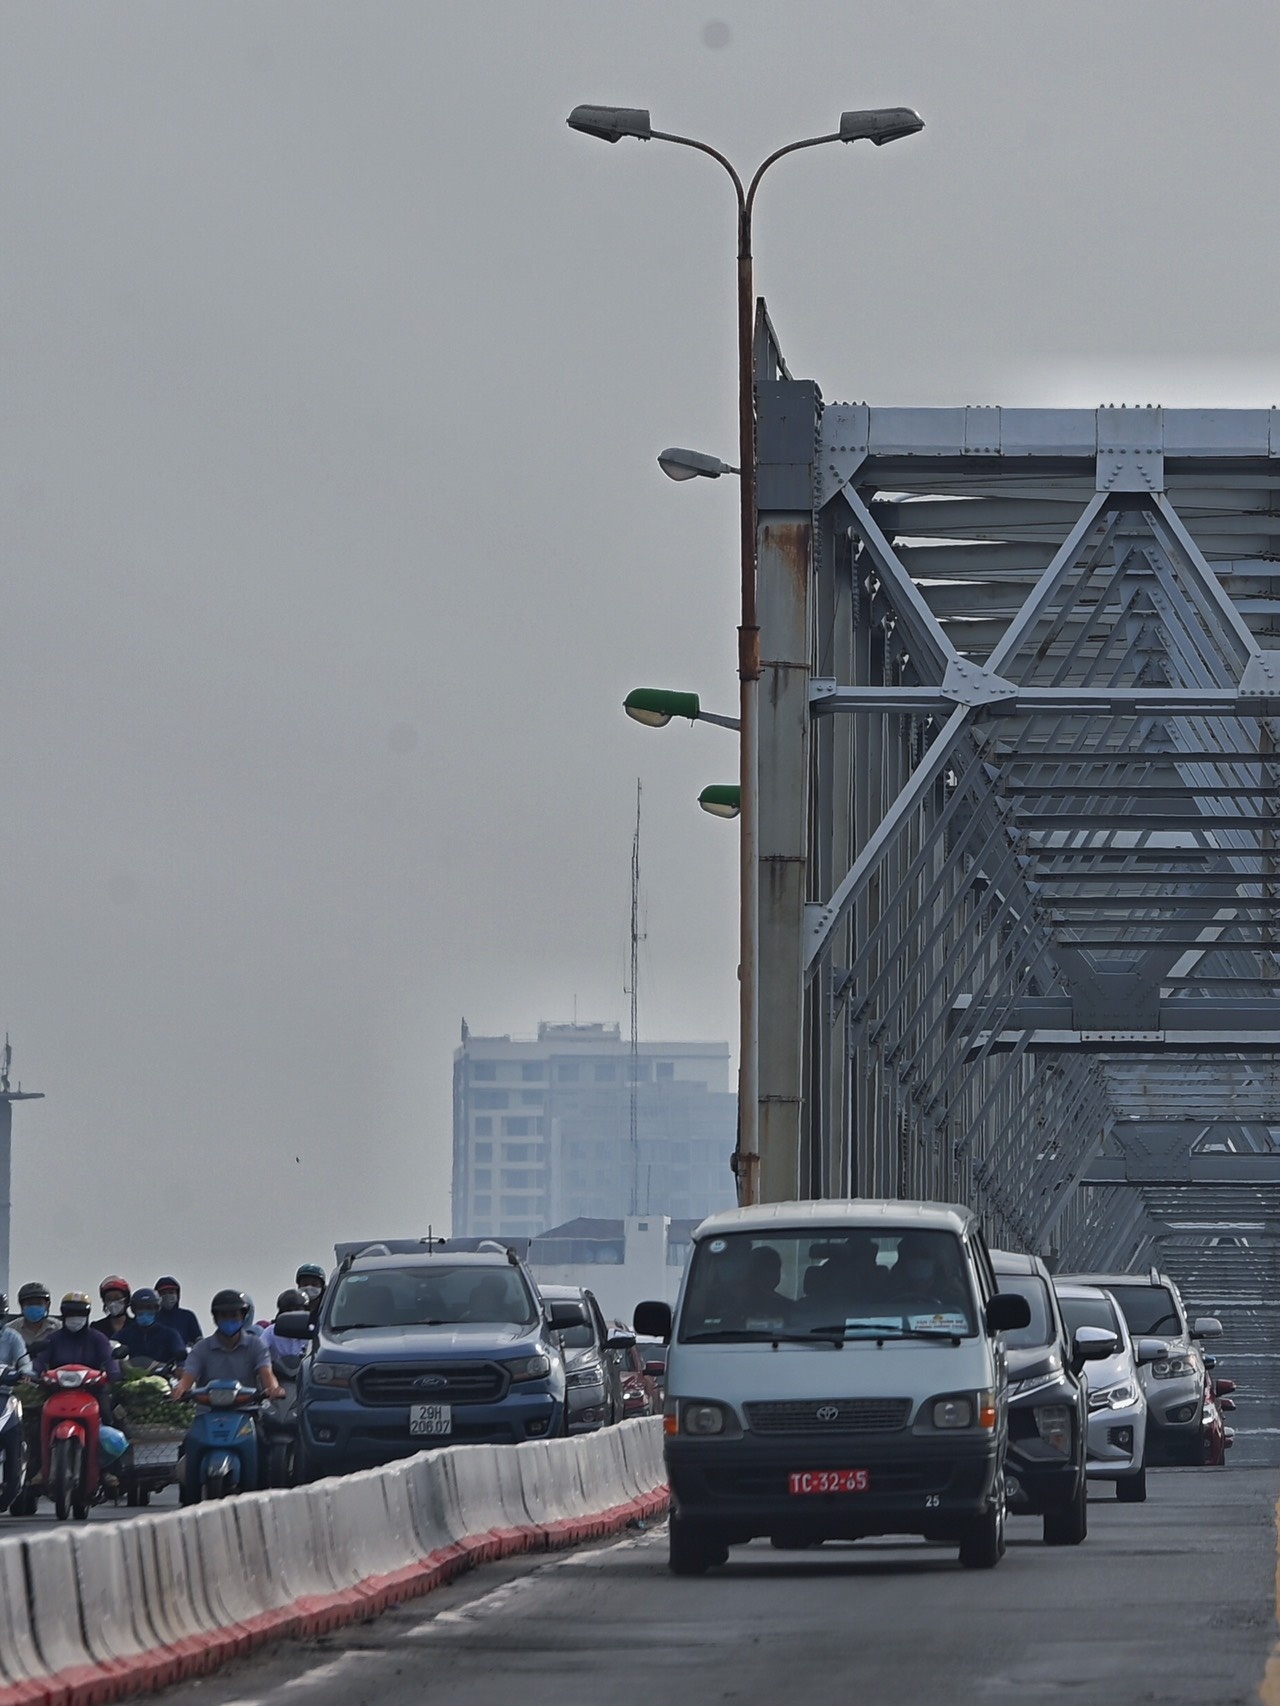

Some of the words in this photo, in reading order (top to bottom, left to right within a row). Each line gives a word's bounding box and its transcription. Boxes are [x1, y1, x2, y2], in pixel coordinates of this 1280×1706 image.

[420, 1406, 442, 1420] 29H
[791, 1471, 867, 1493] TC-32-65
[925, 1494, 940, 1508] 25
